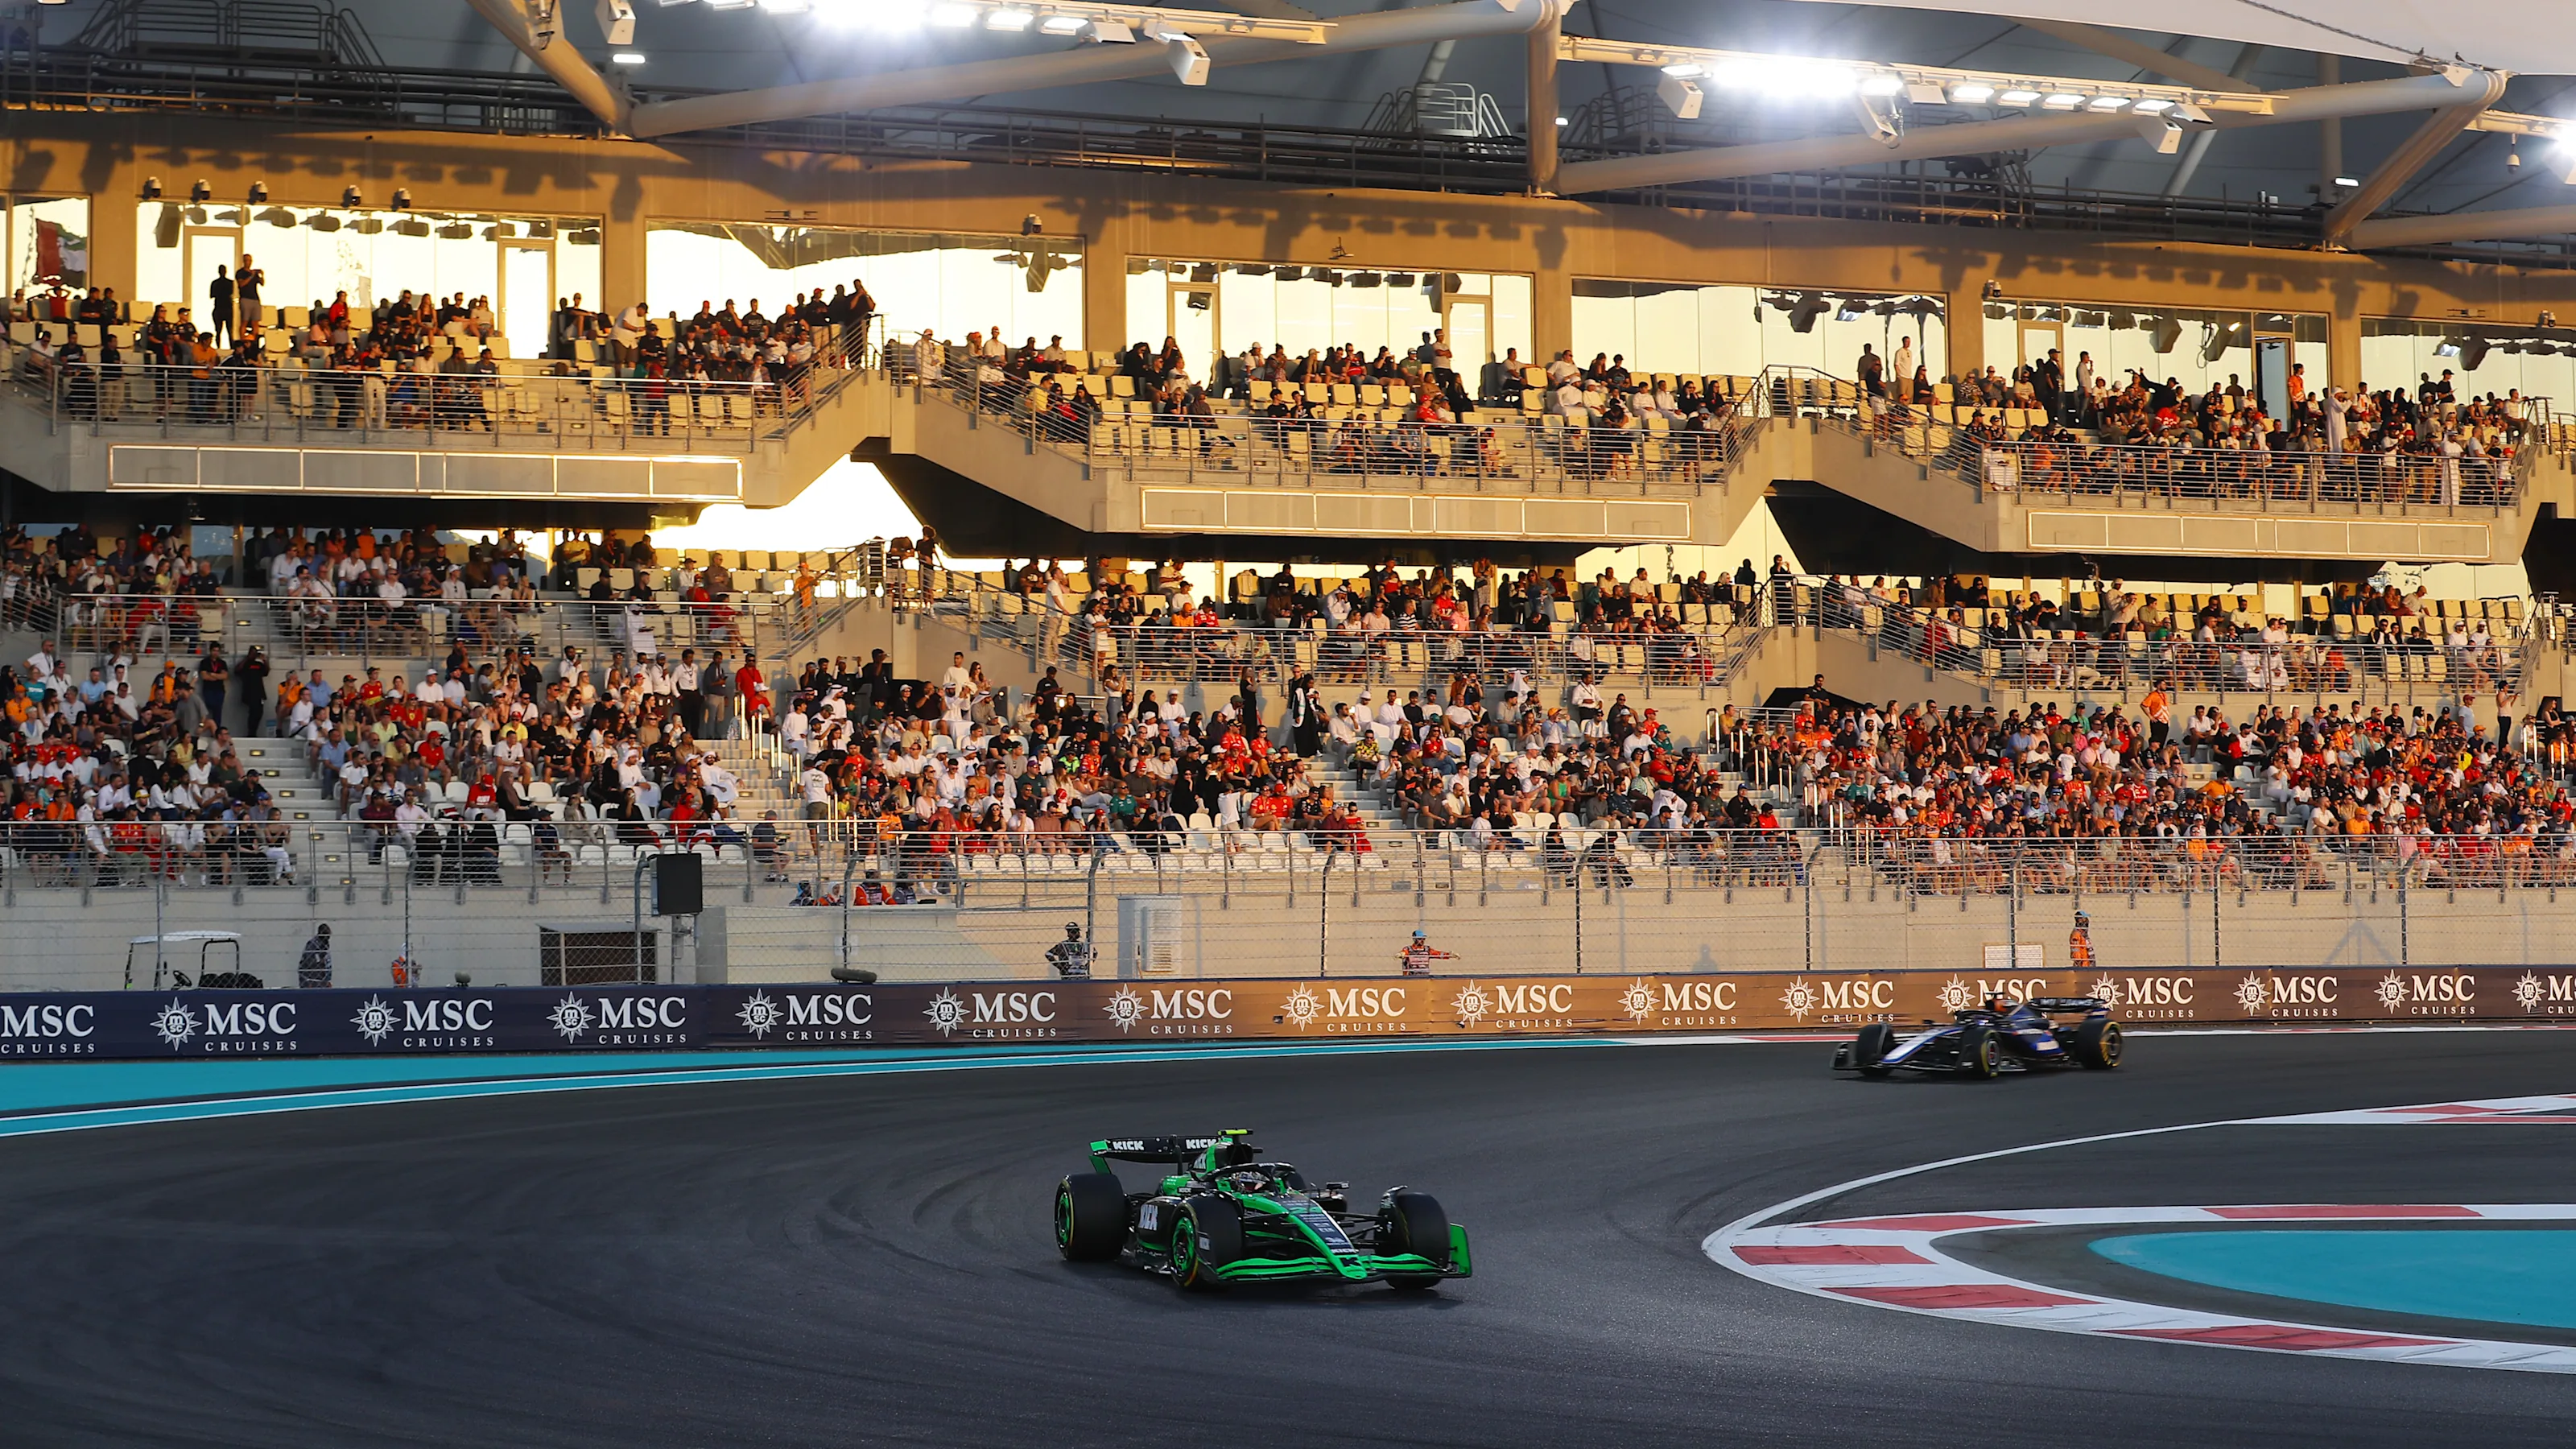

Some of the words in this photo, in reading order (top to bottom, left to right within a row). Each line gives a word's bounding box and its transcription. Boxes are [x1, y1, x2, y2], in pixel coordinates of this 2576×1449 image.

[1662, 983, 1736, 1010] MSC
[1821, 980, 1894, 1008] MSC
[1976, 978, 2047, 1007] MSC
[2126, 977, 2194, 1004] MSC
[2272, 976, 2338, 1003] MSC
[2412, 976, 2475, 1001] MSC
[2548, 976, 2576, 1001] M
[972, 993, 1055, 1022] MSC
[1150, 989, 1232, 1018] MSC
[1327, 988, 1406, 1017] MSC
[1496, 985, 1572, 1013] MSC
[205, 1003, 296, 1034] MSC
[403, 1000, 493, 1030] MSC
[599, 997, 686, 1028] MSC
[786, 994, 872, 1025] MSC
[1821, 1013, 1894, 1023] CRUISES
[2125, 1009, 2194, 1018] CRUISES
[2271, 1008, 2338, 1017] CRUISES
[2411, 1006, 2475, 1015] CRUISES
[1, 1005, 94, 1037] MSC
[1150, 1025, 1232, 1034] CRUISES
[1327, 1022, 1406, 1031] CRUISES
[1496, 1019, 1573, 1028] CRUISES
[1662, 1016, 1736, 1025] CRUISES
[403, 1036, 493, 1046] CRUISES
[598, 1034, 686, 1044] CRUISES
[786, 1030, 872, 1041] CRUISES
[972, 1028, 1056, 1038] CRUISES
[1, 1043, 95, 1054] CRUISES
[204, 1040, 297, 1051] CRUISES
[1112, 1139, 1145, 1151] KICK
[1185, 1138, 1216, 1150] KICK
